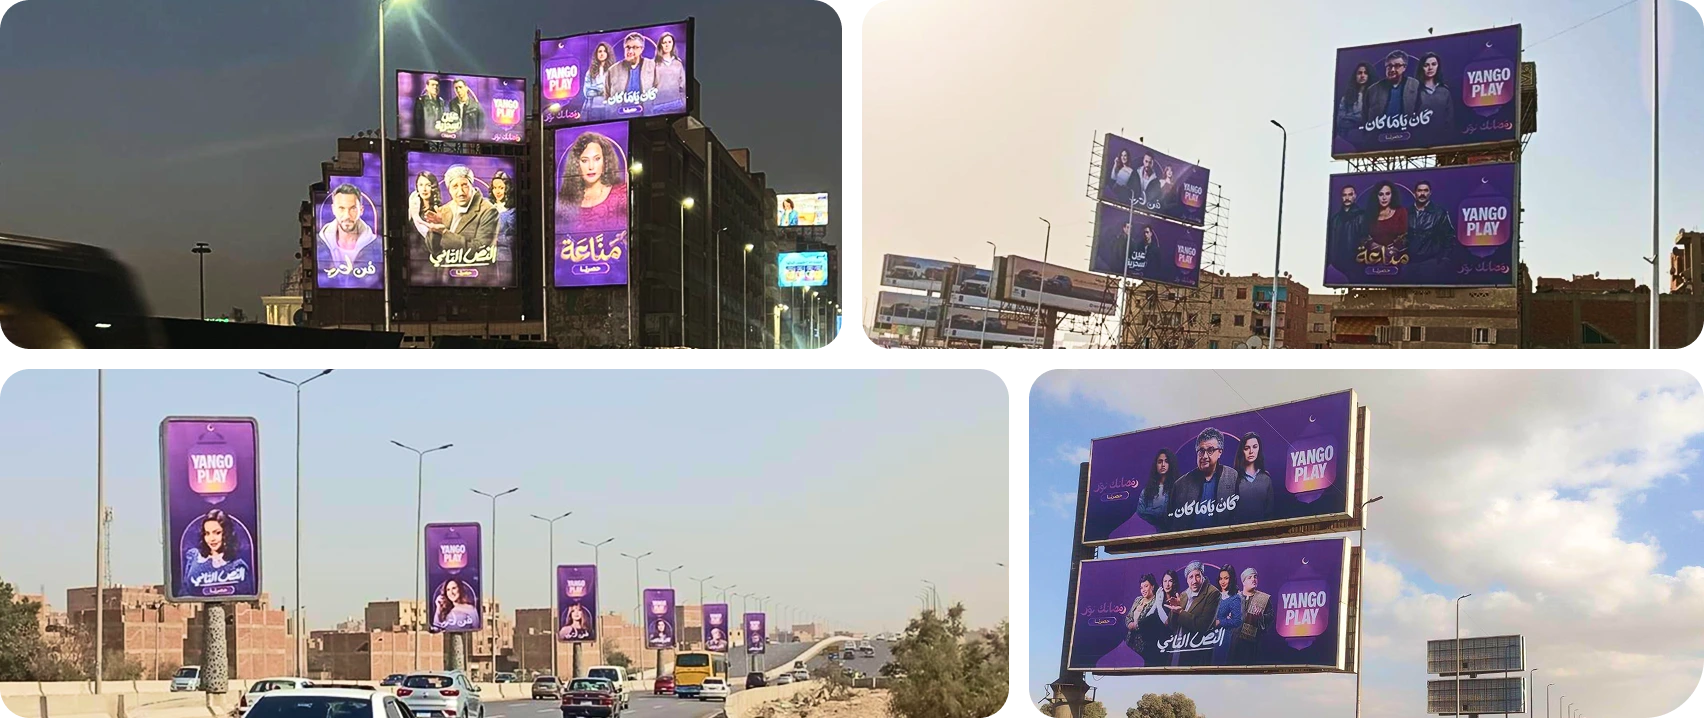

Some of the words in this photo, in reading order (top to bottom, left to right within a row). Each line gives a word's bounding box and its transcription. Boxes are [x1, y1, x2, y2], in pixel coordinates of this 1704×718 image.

[545, 65, 578, 80] YANGO
[1467, 67, 1511, 85] YANGO
[549, 78, 573, 92] PLAY
[1471, 82, 1504, 98] PLAY
[493, 98, 519, 111] YANGO
[496, 108, 515, 118] PLAY
[1183, 182, 1203, 195] YANGO
[1184, 191, 1199, 202] PLAY
[1462, 206, 1508, 222] YANGO
[1466, 221, 1500, 237] PLAY
[1177, 244, 1197, 257] YANGO
[1178, 253, 1193, 264] PLAY
[191, 454, 234, 470] YANGO
[1290, 444, 1334, 467] YANGO
[197, 469, 228, 484] PLAY
[1294, 463, 1327, 483] PLAY
[440, 544, 466, 554] YANGO
[443, 553, 462, 563] PLAY
[1281, 590, 1327, 609] YANGO
[1285, 608, 1318, 626] PLAY
